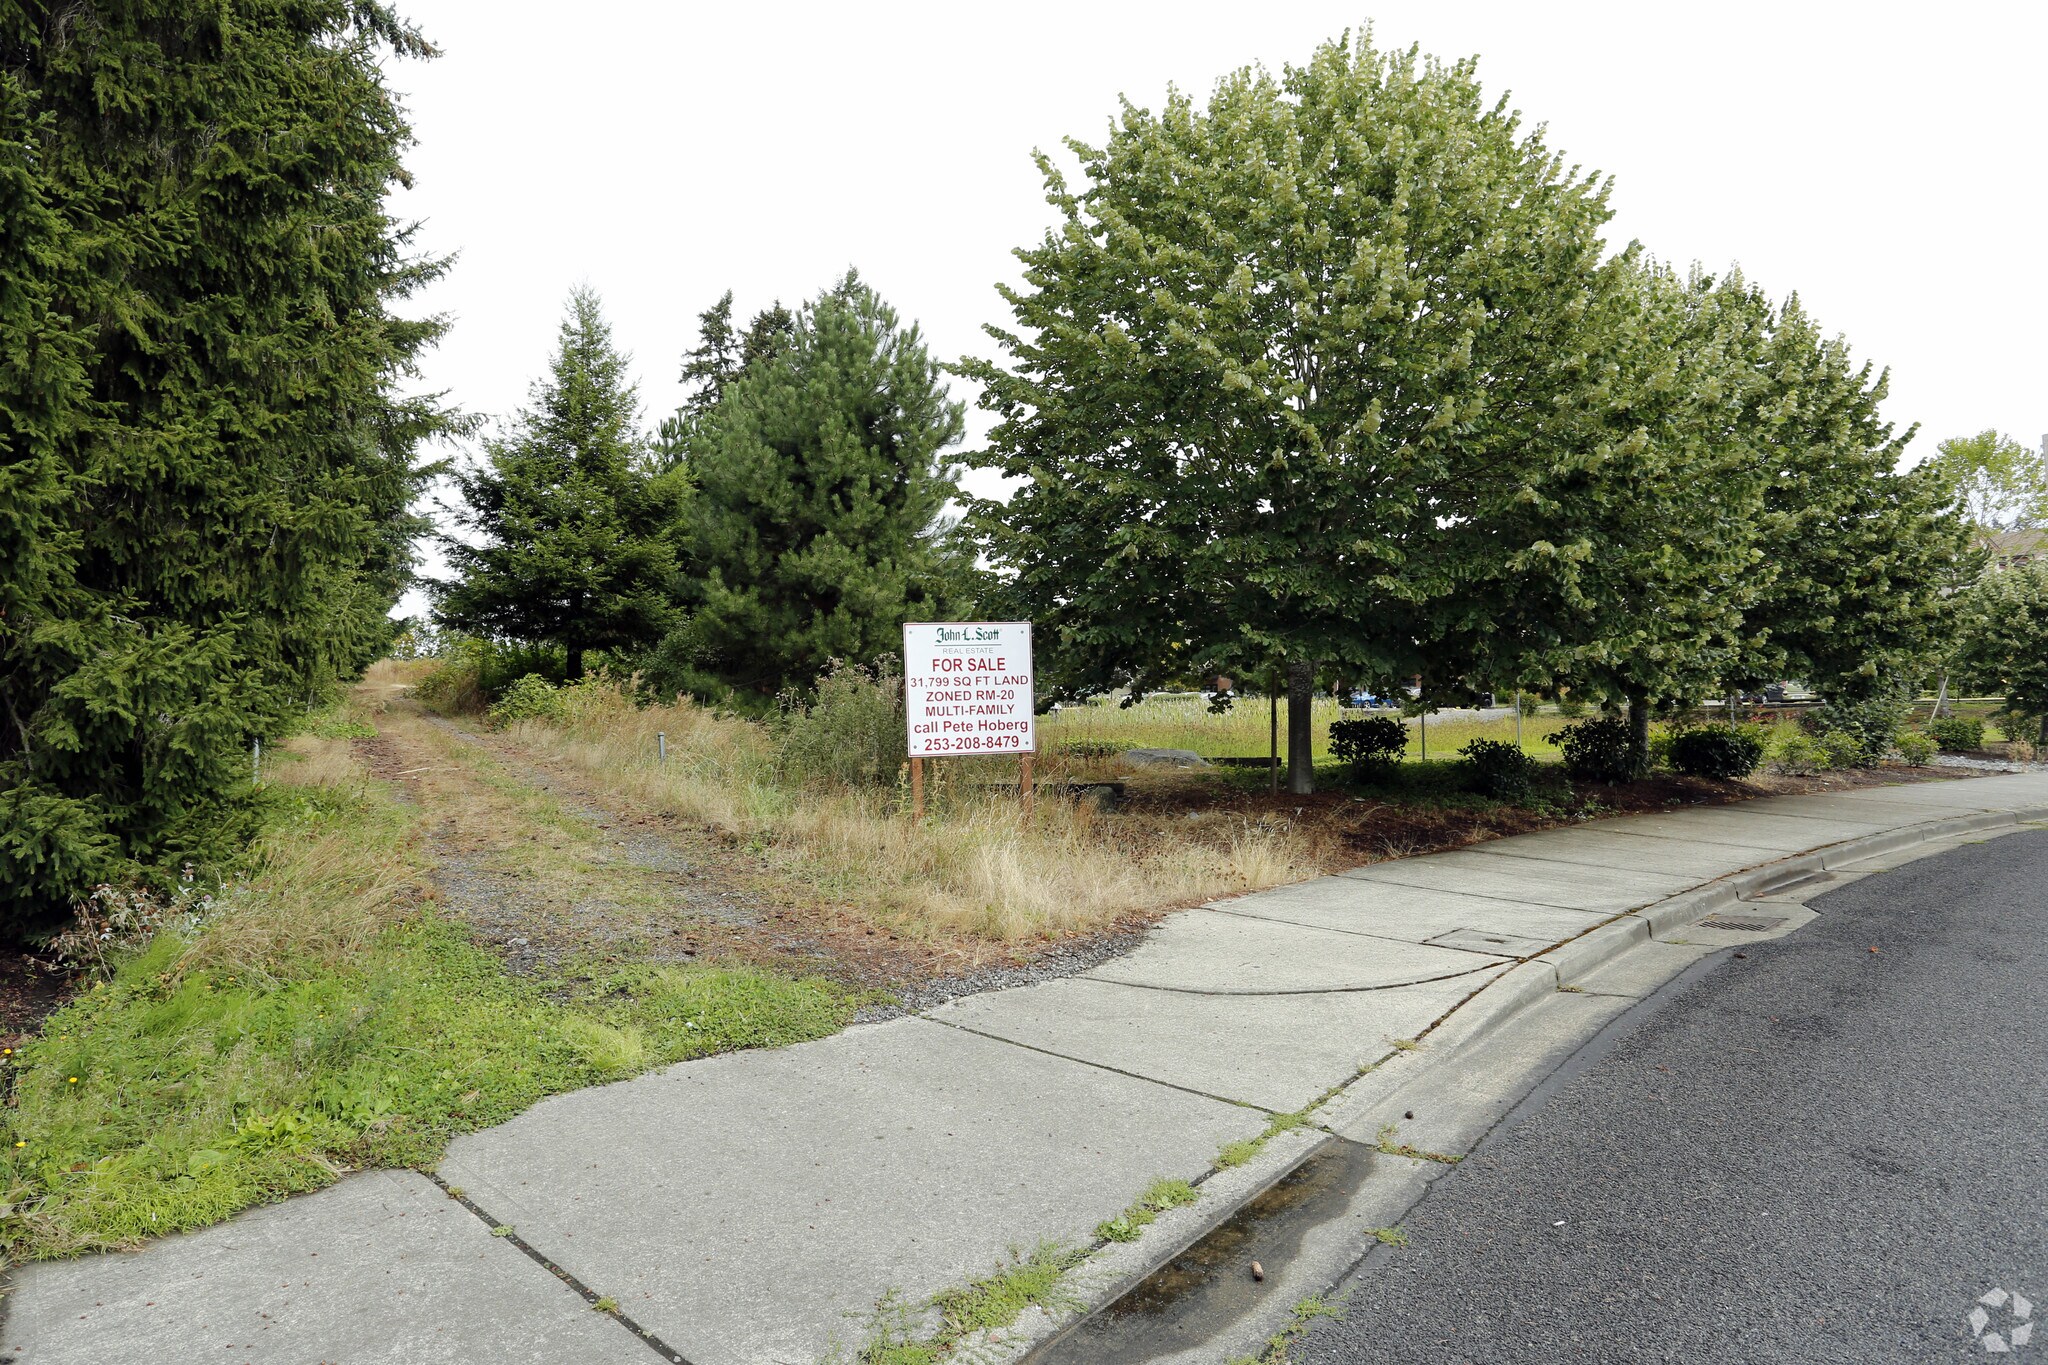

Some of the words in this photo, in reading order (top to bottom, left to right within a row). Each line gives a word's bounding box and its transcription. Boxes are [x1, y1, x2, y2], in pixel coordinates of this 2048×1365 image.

[935, 627, 960, 643] John
[962, 627, 974, 640] L.
[976, 627, 999, 640] Scott
[932, 659, 963, 672] FOR
[968, 658, 1006, 671] SALE
[910, 678, 949, 688] 31,799
[954, 677, 971, 686] SQ
[976, 676, 990, 686] FT
[994, 676, 1028, 685] LAND
[926, 691, 972, 702] ZONED
[976, 690, 1014, 700] RM-20
[926, 704, 1014, 716] MULTI-FAMILY
[914, 721, 938, 733] call
[943, 721, 973, 732] Pete
[978, 719, 1028, 732] Hoberg
[924, 736, 1019, 750] 253-208-8479
